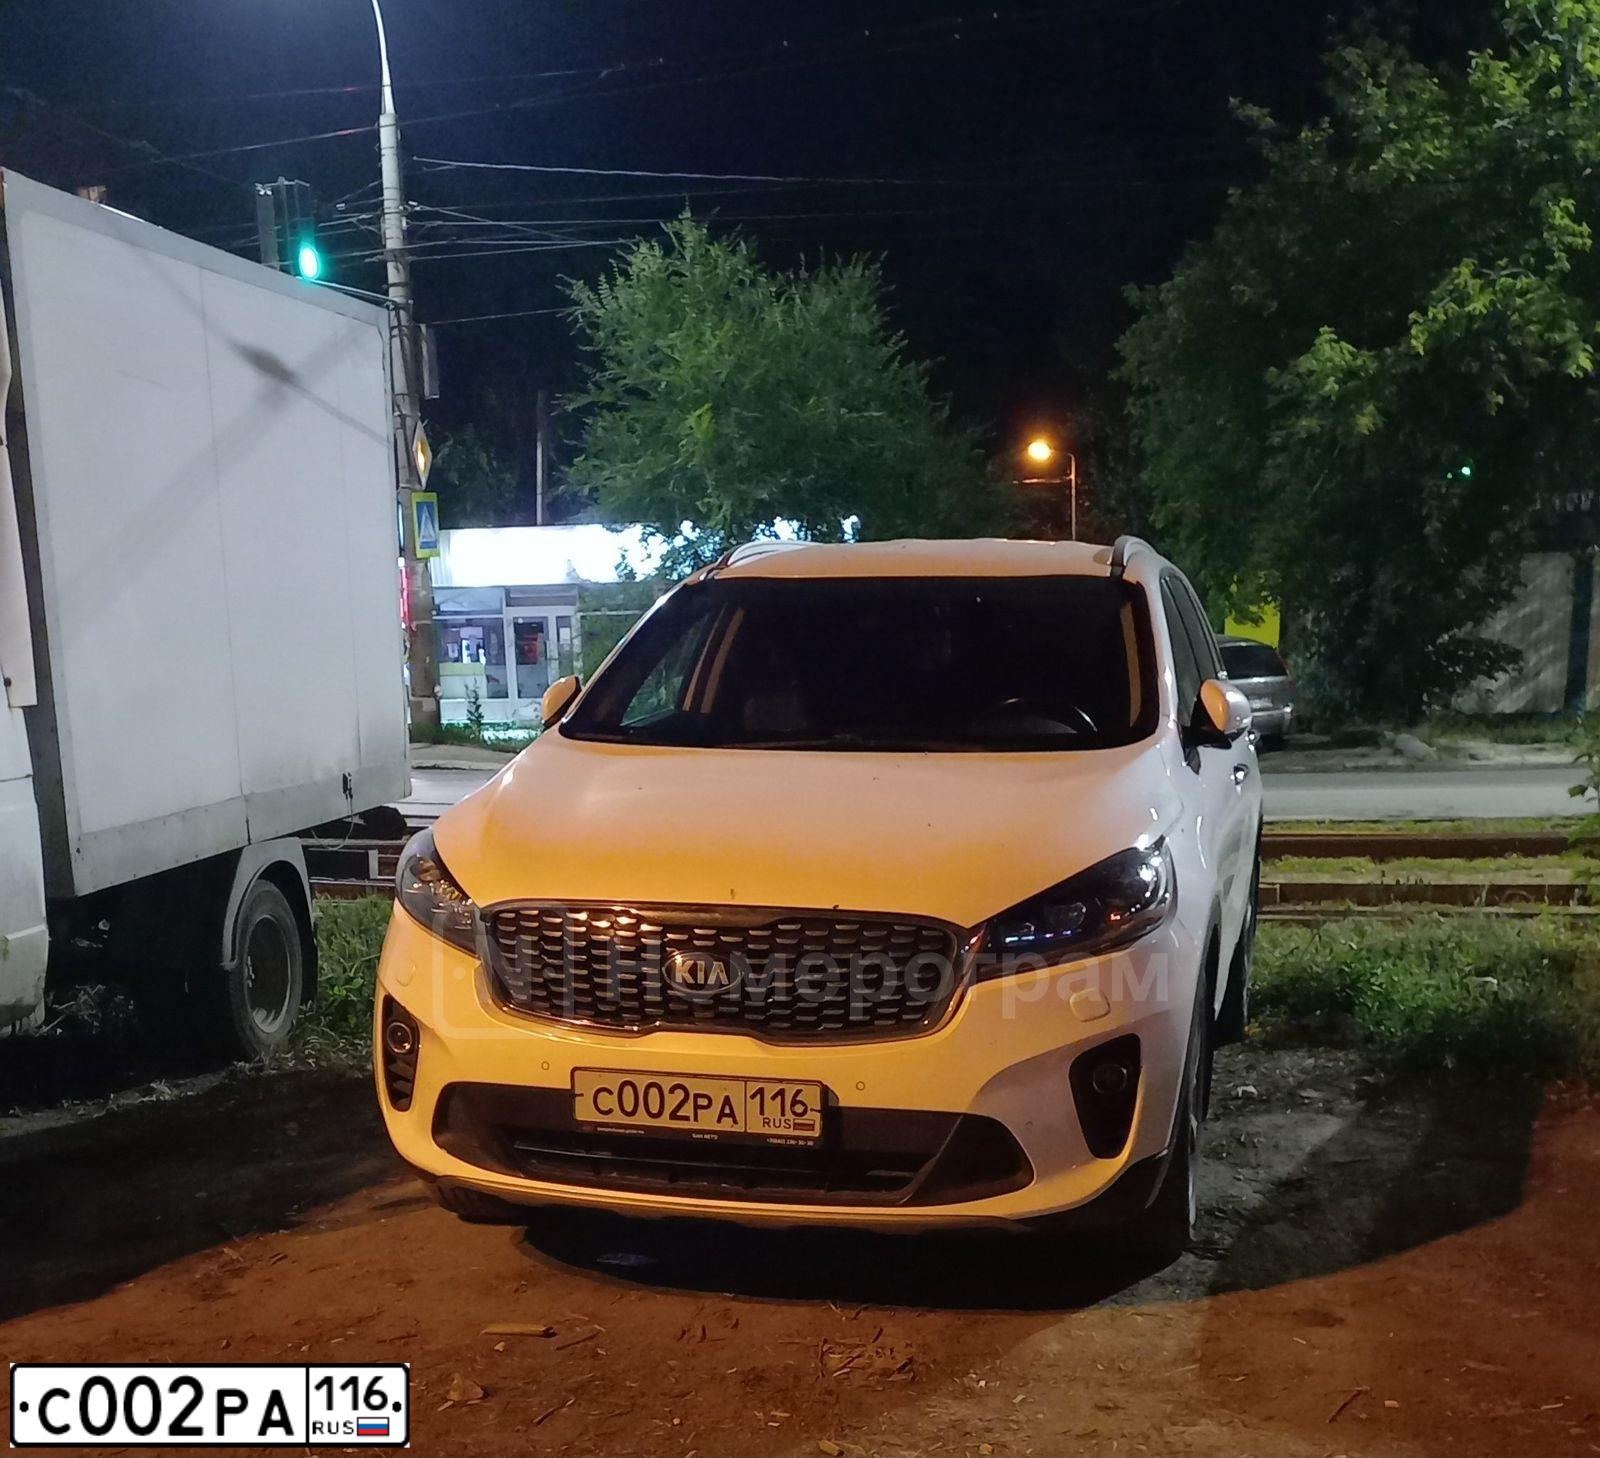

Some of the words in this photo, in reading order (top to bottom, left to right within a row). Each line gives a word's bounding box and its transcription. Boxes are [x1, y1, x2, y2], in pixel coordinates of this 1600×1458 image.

[675, 958, 730, 987] KIA
[592, 1079, 739, 1125] С002РА
[749, 1086, 809, 1118] 116
[762, 1116, 792, 1131] RUS
